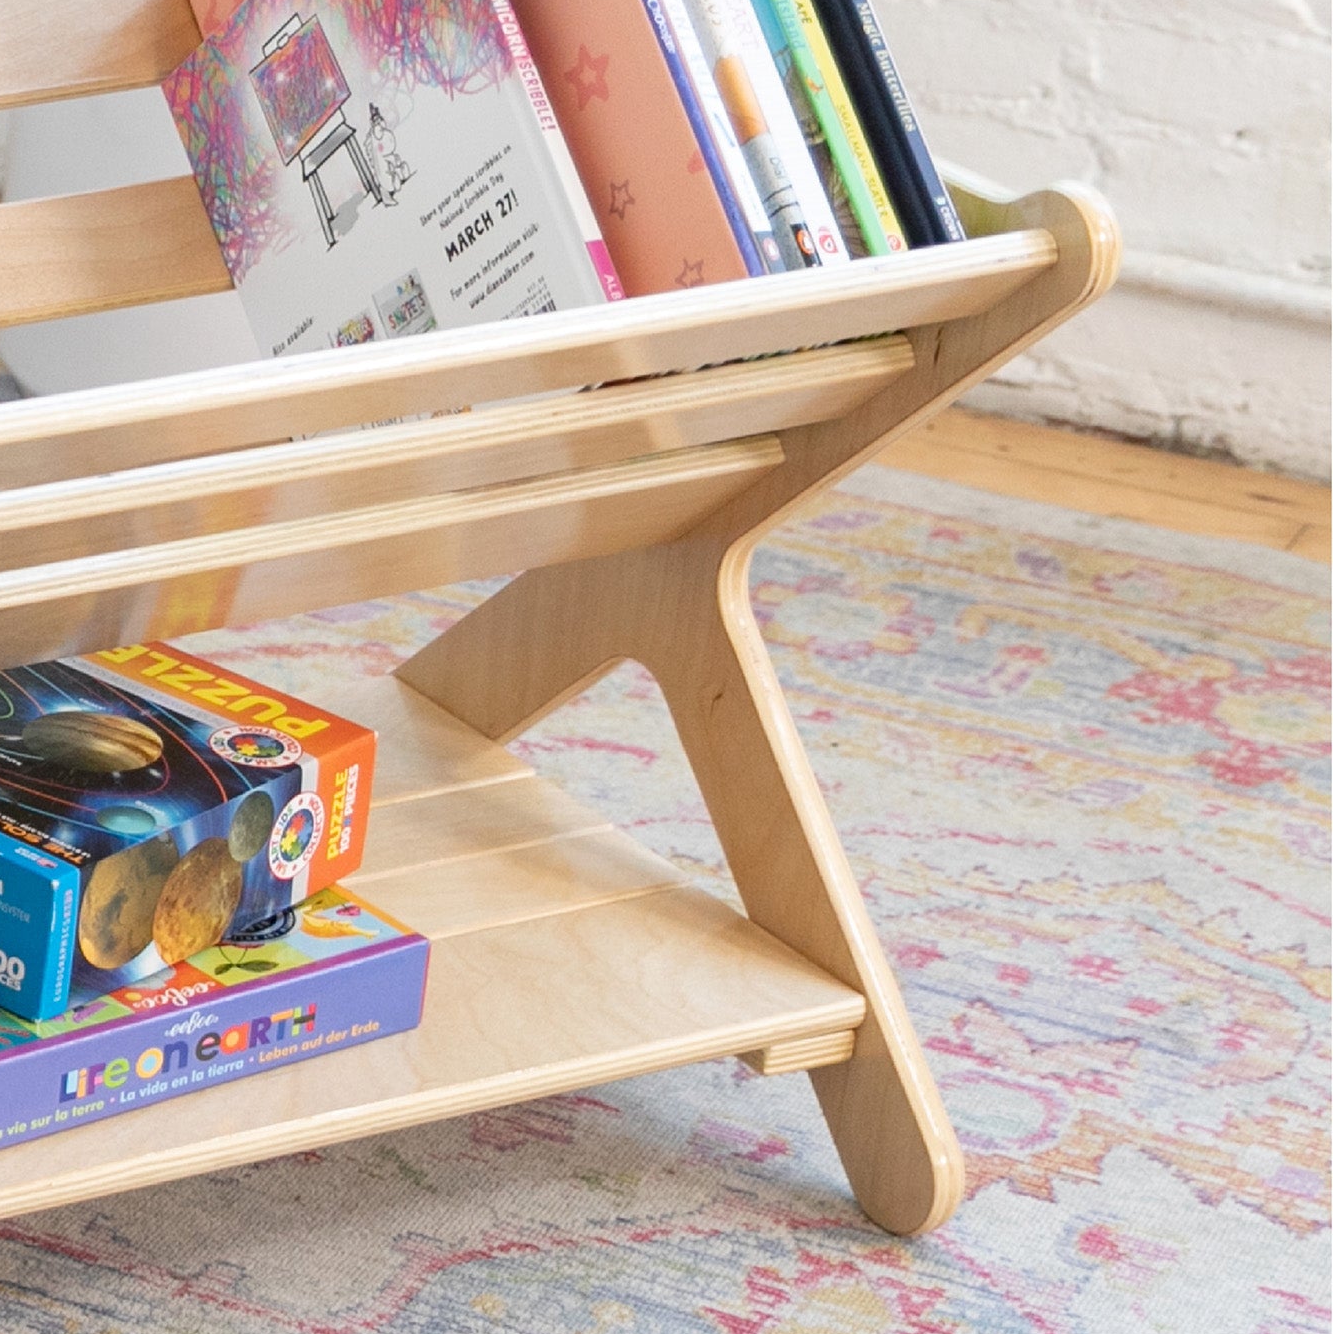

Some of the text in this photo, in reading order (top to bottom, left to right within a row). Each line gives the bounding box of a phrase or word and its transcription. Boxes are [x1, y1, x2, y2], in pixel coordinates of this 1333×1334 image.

[777, 0, 806, 49] Island
[519, 58, 558, 132] SCRIBBLE!
[857, 3, 881, 46] Magic
[876, 48, 917, 133] Butterflies
[489, 173, 504, 187] Day
[444, 188, 519, 262] MARCH 27!
[450, 240, 521, 301] For more information
[96, 644, 331, 740] PUZZLE
[326, 767, 350, 861] PUZZLE
[339, 763, 360, 855] 100 PIECES
[43, 842, 85, 864] THE
[5, 1121, 28, 1136] vie
[30, 1115, 52, 1131] sur
[54, 1105, 69, 1122] la
[71, 1099, 105, 1117] terre
[119, 1089, 136, 1104] La
[138, 1079, 169, 1096] vida
[171, 1076, 189, 1088] en
[191, 1068, 205, 1084] la
[207, 1059, 244, 1077] tierra
[259, 1042, 299, 1064] Leben
[301, 1034, 325, 1053] auf
[326, 1027, 349, 1045] der
[351, 1019, 380, 1039] Erde
[135, 1040, 189, 1080] on
